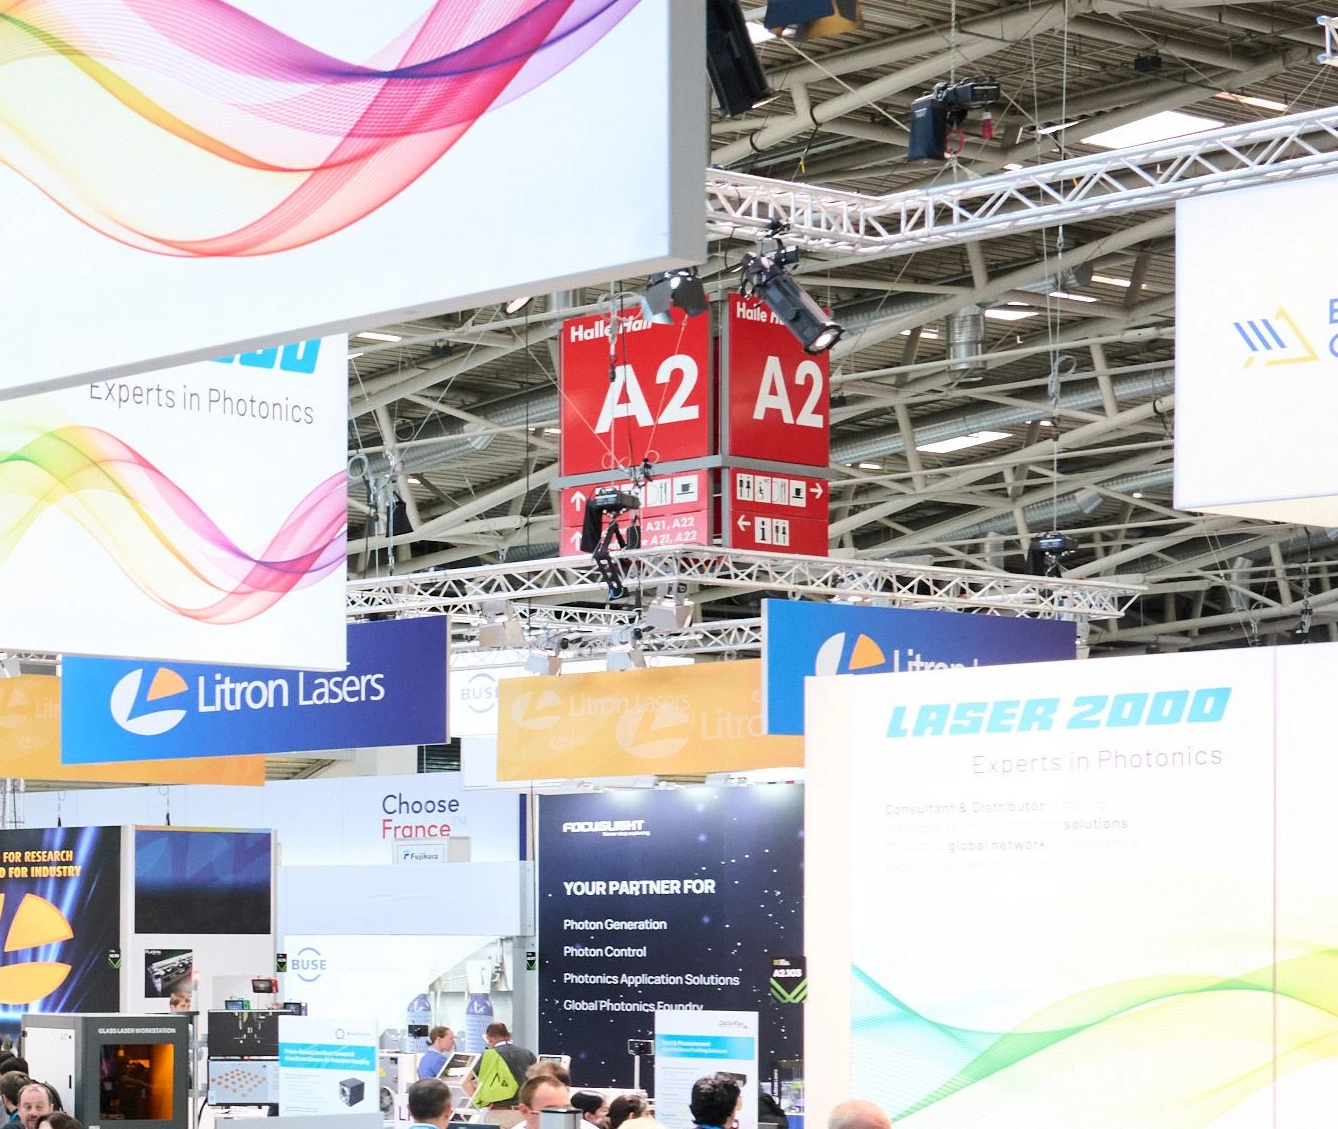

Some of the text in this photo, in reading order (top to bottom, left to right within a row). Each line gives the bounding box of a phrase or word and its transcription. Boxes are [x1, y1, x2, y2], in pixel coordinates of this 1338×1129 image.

[736, 302, 767, 322] Halle
[594, 354, 700, 434] A2
[753, 355, 824, 429] A2
[182, 386, 200, 411] in
[209, 388, 314, 425] Photonics
[673, 516, 695, 529] A22
[675, 530, 698, 544] A22
[197, 669, 385, 713] Litron Lasers
[570, 693, 628, 716] Litron
[886, 687, 1233, 738] LASER 2000
[973, 746, 1223, 776] Experts in Photonics
[382, 793, 460, 815] Choose
[885, 801, 1045, 816] Consultant & Distributor
[382, 818, 451, 838] France
[1063, 817, 1129, 831] solutions
[948, 840, 987, 854] global
[991, 838, 1046, 852] network
[3, 849, 74, 863] FOR RESEARCH
[8, 865, 81, 878] FOR INDUSTRY
[563, 879, 716, 896] YOUR PARTNER FOR
[563, 918, 667, 931] Photon Generation
[563, 945, 647, 958] Photon Control
[291, 959, 327, 971] BUSE
[563, 972, 740, 988] Photonics Application Solutions
[563, 999, 598, 1012] Global
[599, 999, 655, 1012] Photonics
